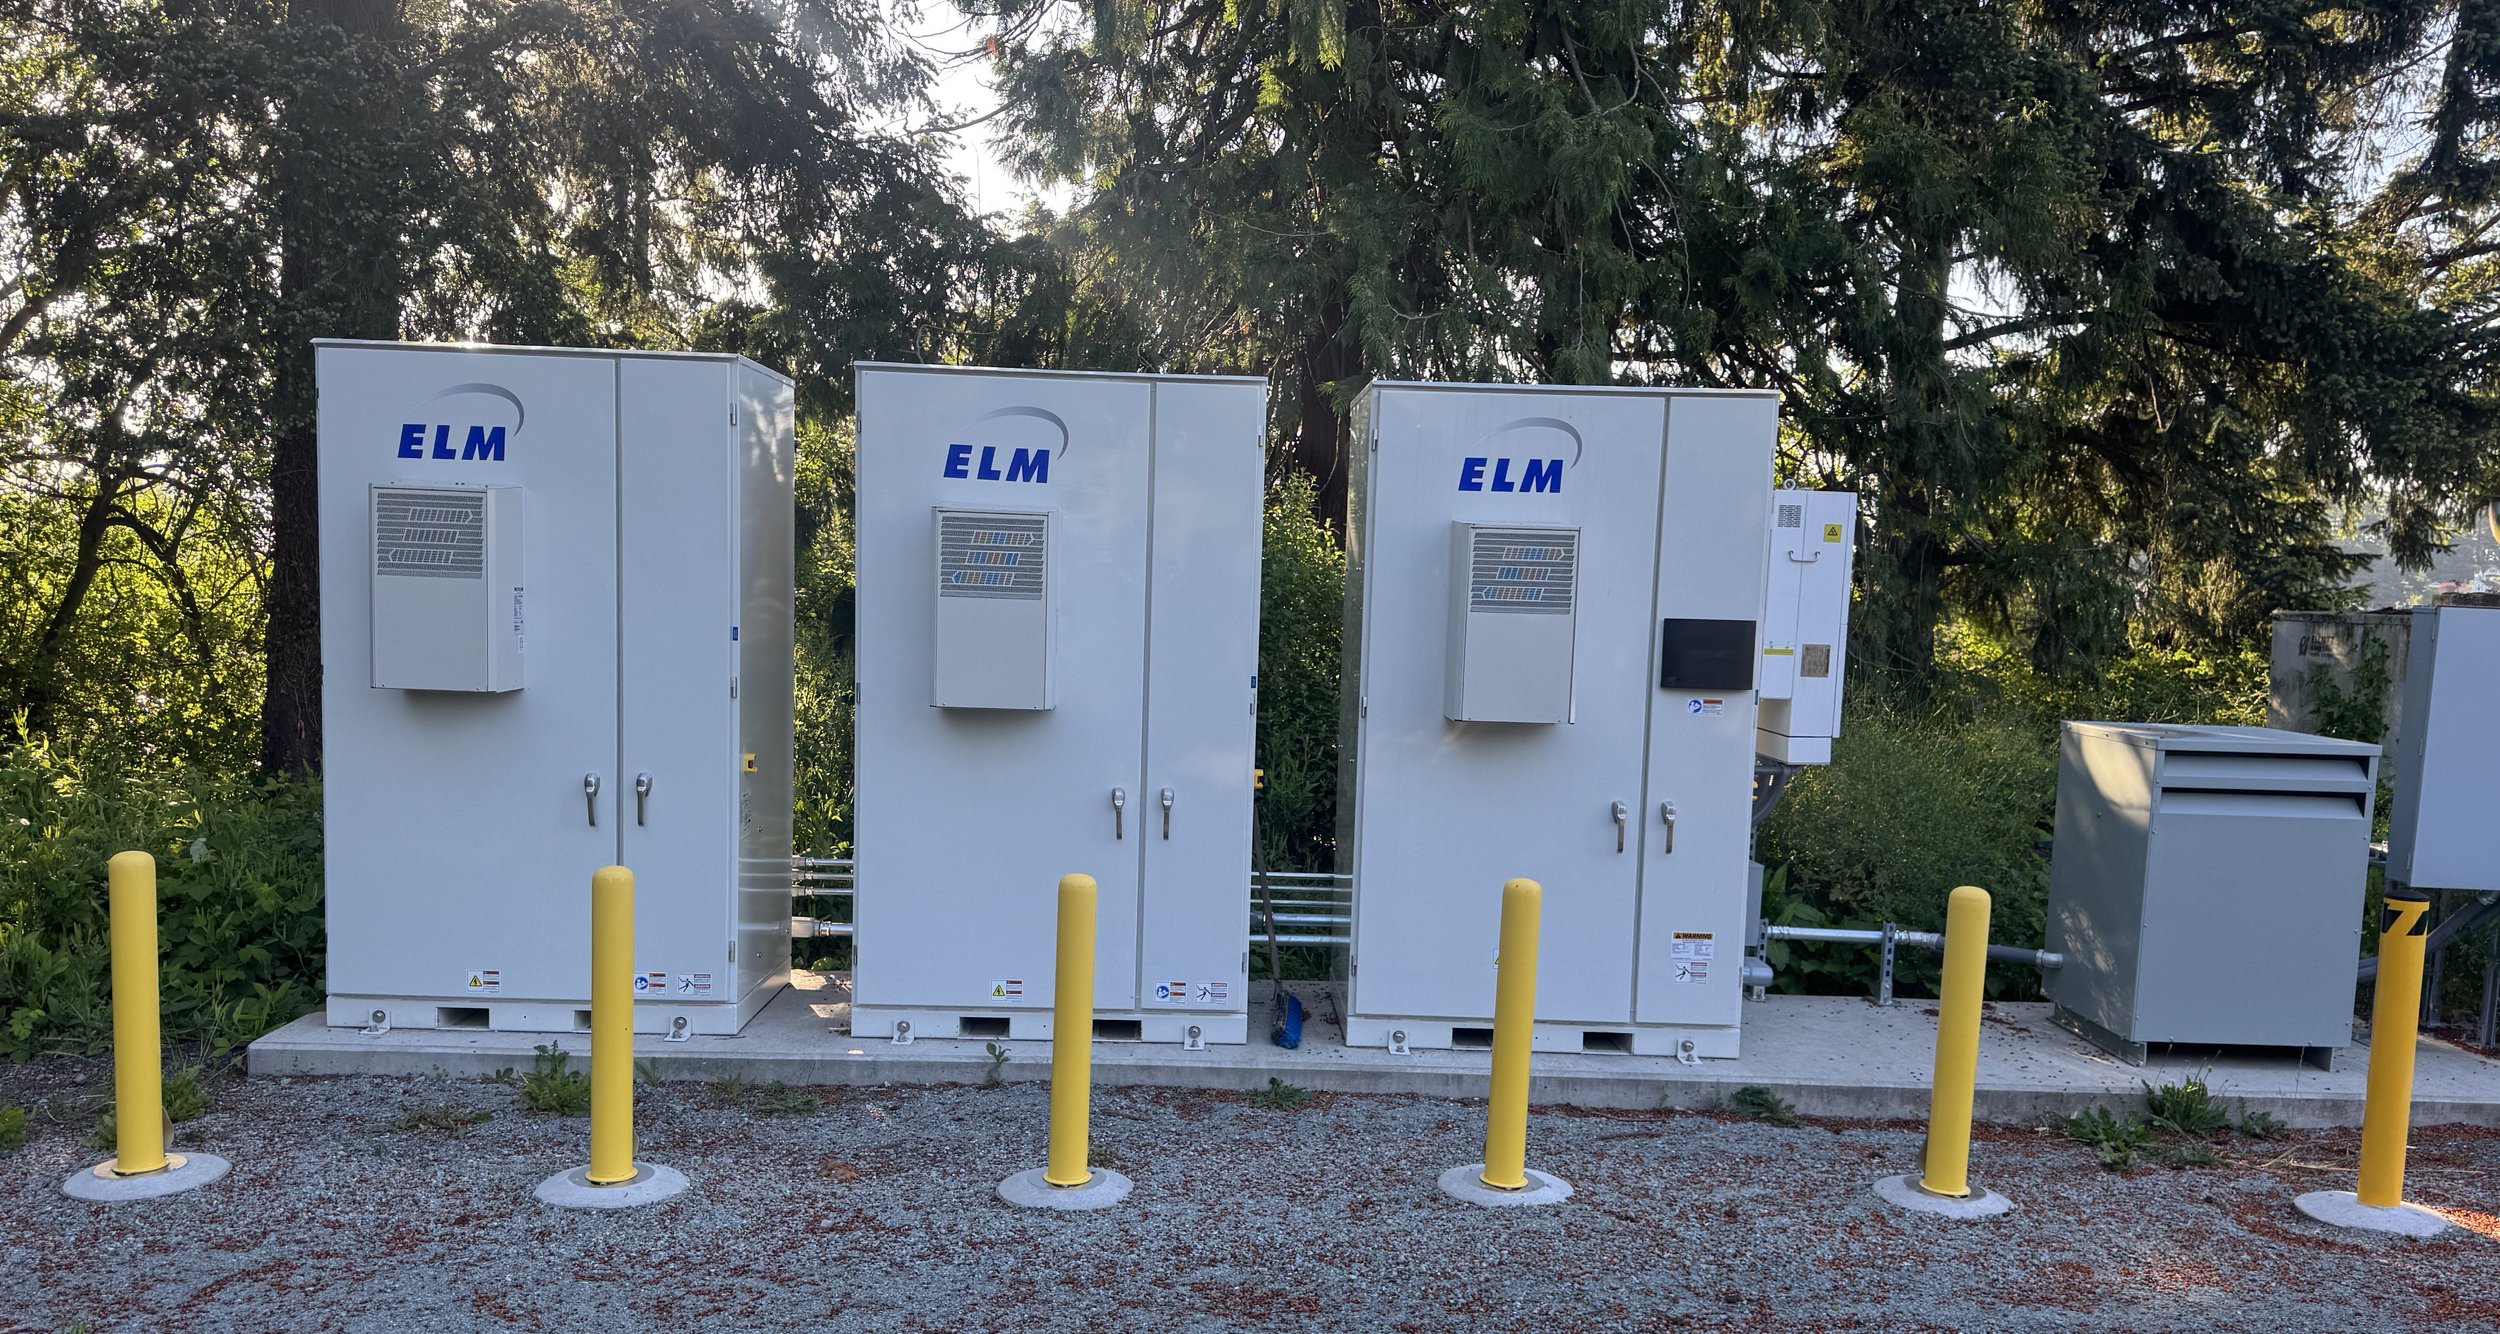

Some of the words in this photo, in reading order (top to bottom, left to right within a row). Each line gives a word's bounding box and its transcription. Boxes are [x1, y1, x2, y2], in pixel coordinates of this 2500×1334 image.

[398, 423, 506, 461] ELM
[943, 443, 1050, 484] ELM
[1457, 455, 1564, 494] ELM
[1682, 932, 1712, 940] WARNING
